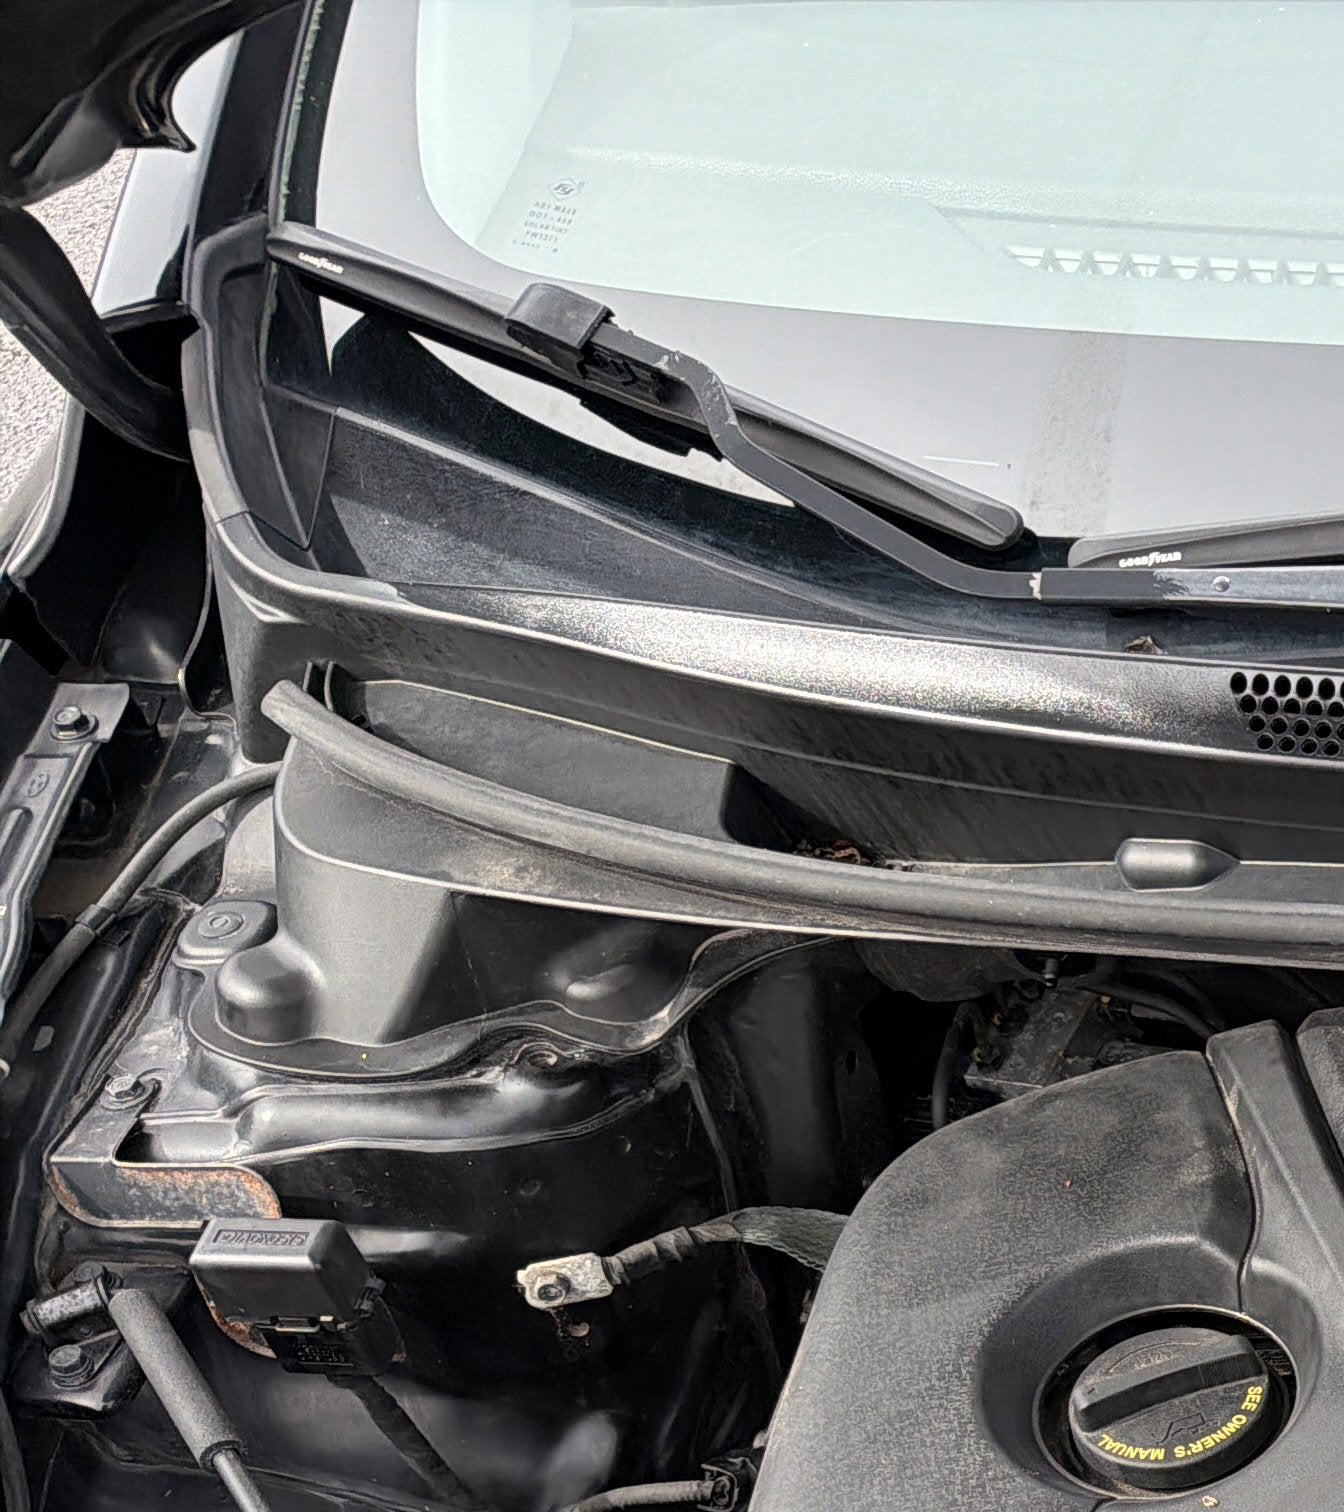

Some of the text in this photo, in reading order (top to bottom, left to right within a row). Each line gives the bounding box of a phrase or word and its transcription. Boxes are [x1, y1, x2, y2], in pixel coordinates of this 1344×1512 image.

[1118, 551, 1182, 568] GOODYEAR
[1097, 1385, 1264, 1461] SEE OWNER'S MANUAL
